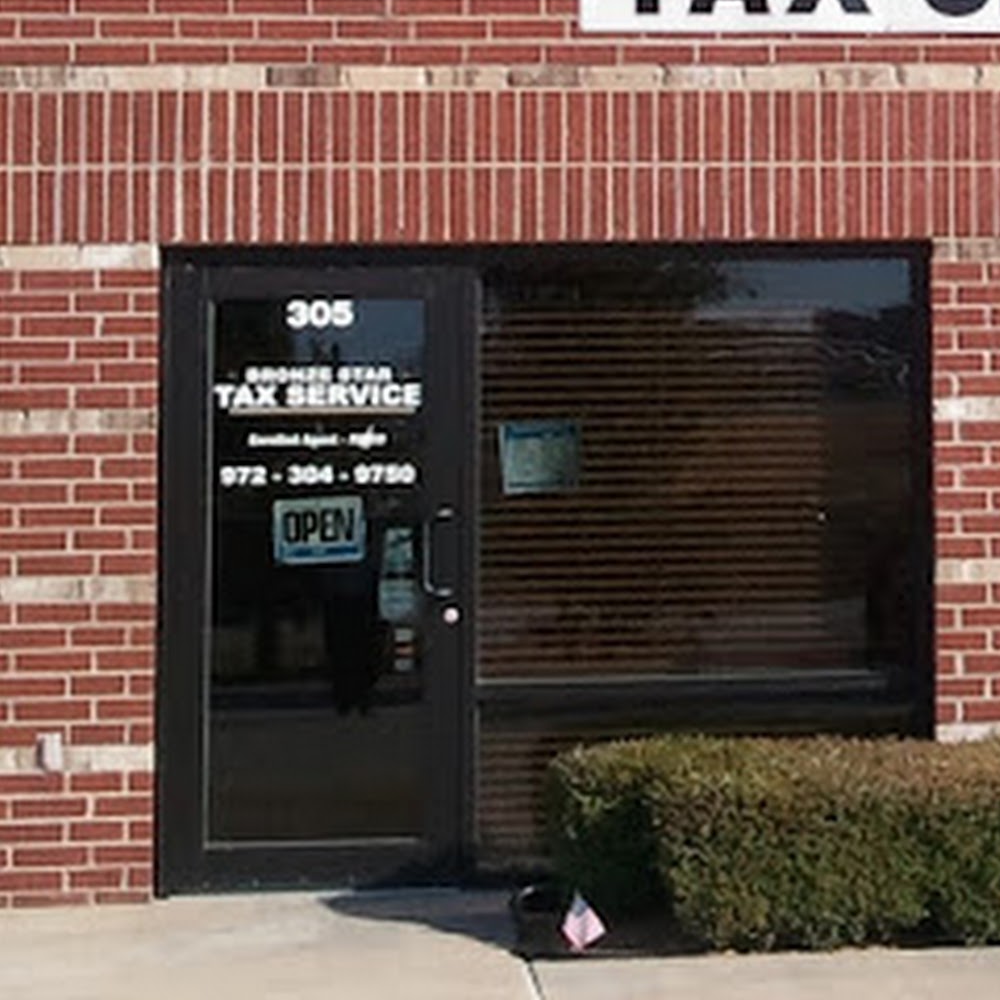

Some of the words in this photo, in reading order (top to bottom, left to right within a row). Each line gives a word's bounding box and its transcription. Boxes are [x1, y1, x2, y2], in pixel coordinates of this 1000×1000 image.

[286, 299, 354, 328] 305
[214, 384, 279, 408] TAX
[286, 383, 421, 407] SERVICE
[220, 465, 267, 486] 972
[283, 506, 355, 544] OPEN
